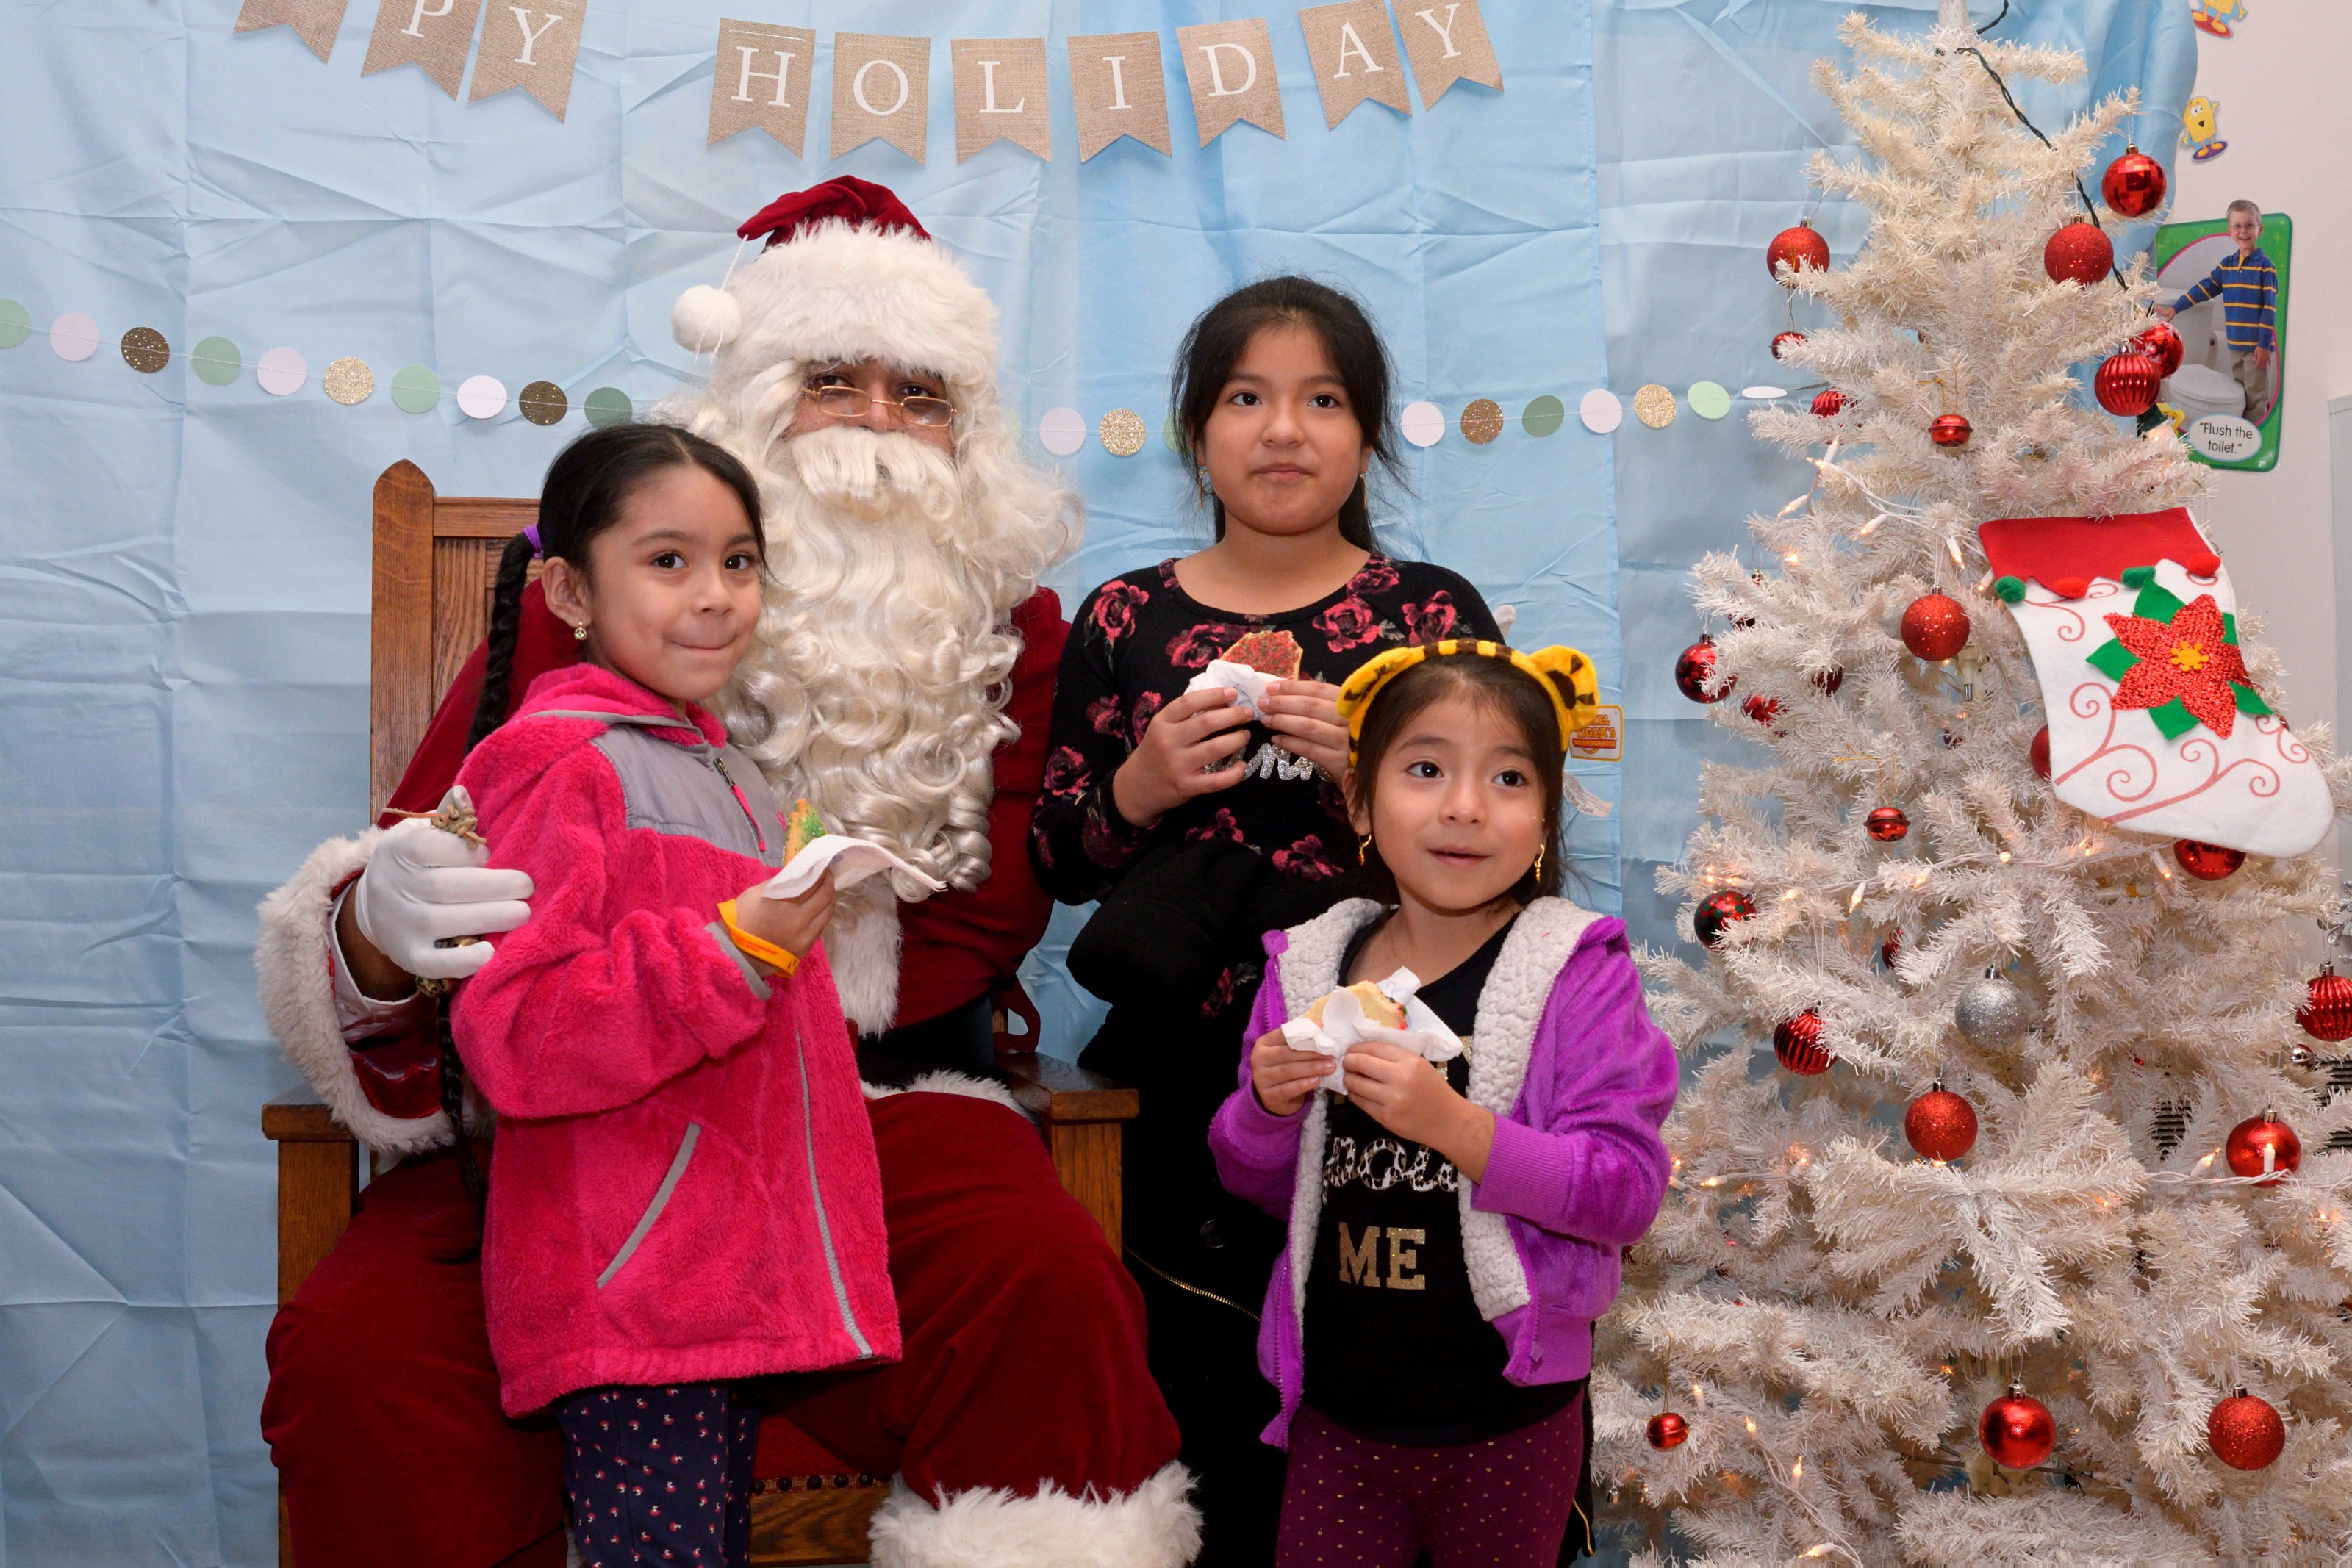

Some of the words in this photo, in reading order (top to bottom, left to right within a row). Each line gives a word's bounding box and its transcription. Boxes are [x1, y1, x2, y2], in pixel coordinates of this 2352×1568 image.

[731, 3, 1460, 115] HOLIDAY
[2199, 422, 2231, 436] "Flush
[2235, 426, 2253, 439] the
[2208, 440, 2242, 454] toilet."
[1576, 727, 1616, 739] TIGER'S
[1580, 804, 1594, 813] Sale
[1338, 1220, 1426, 1290] ME
